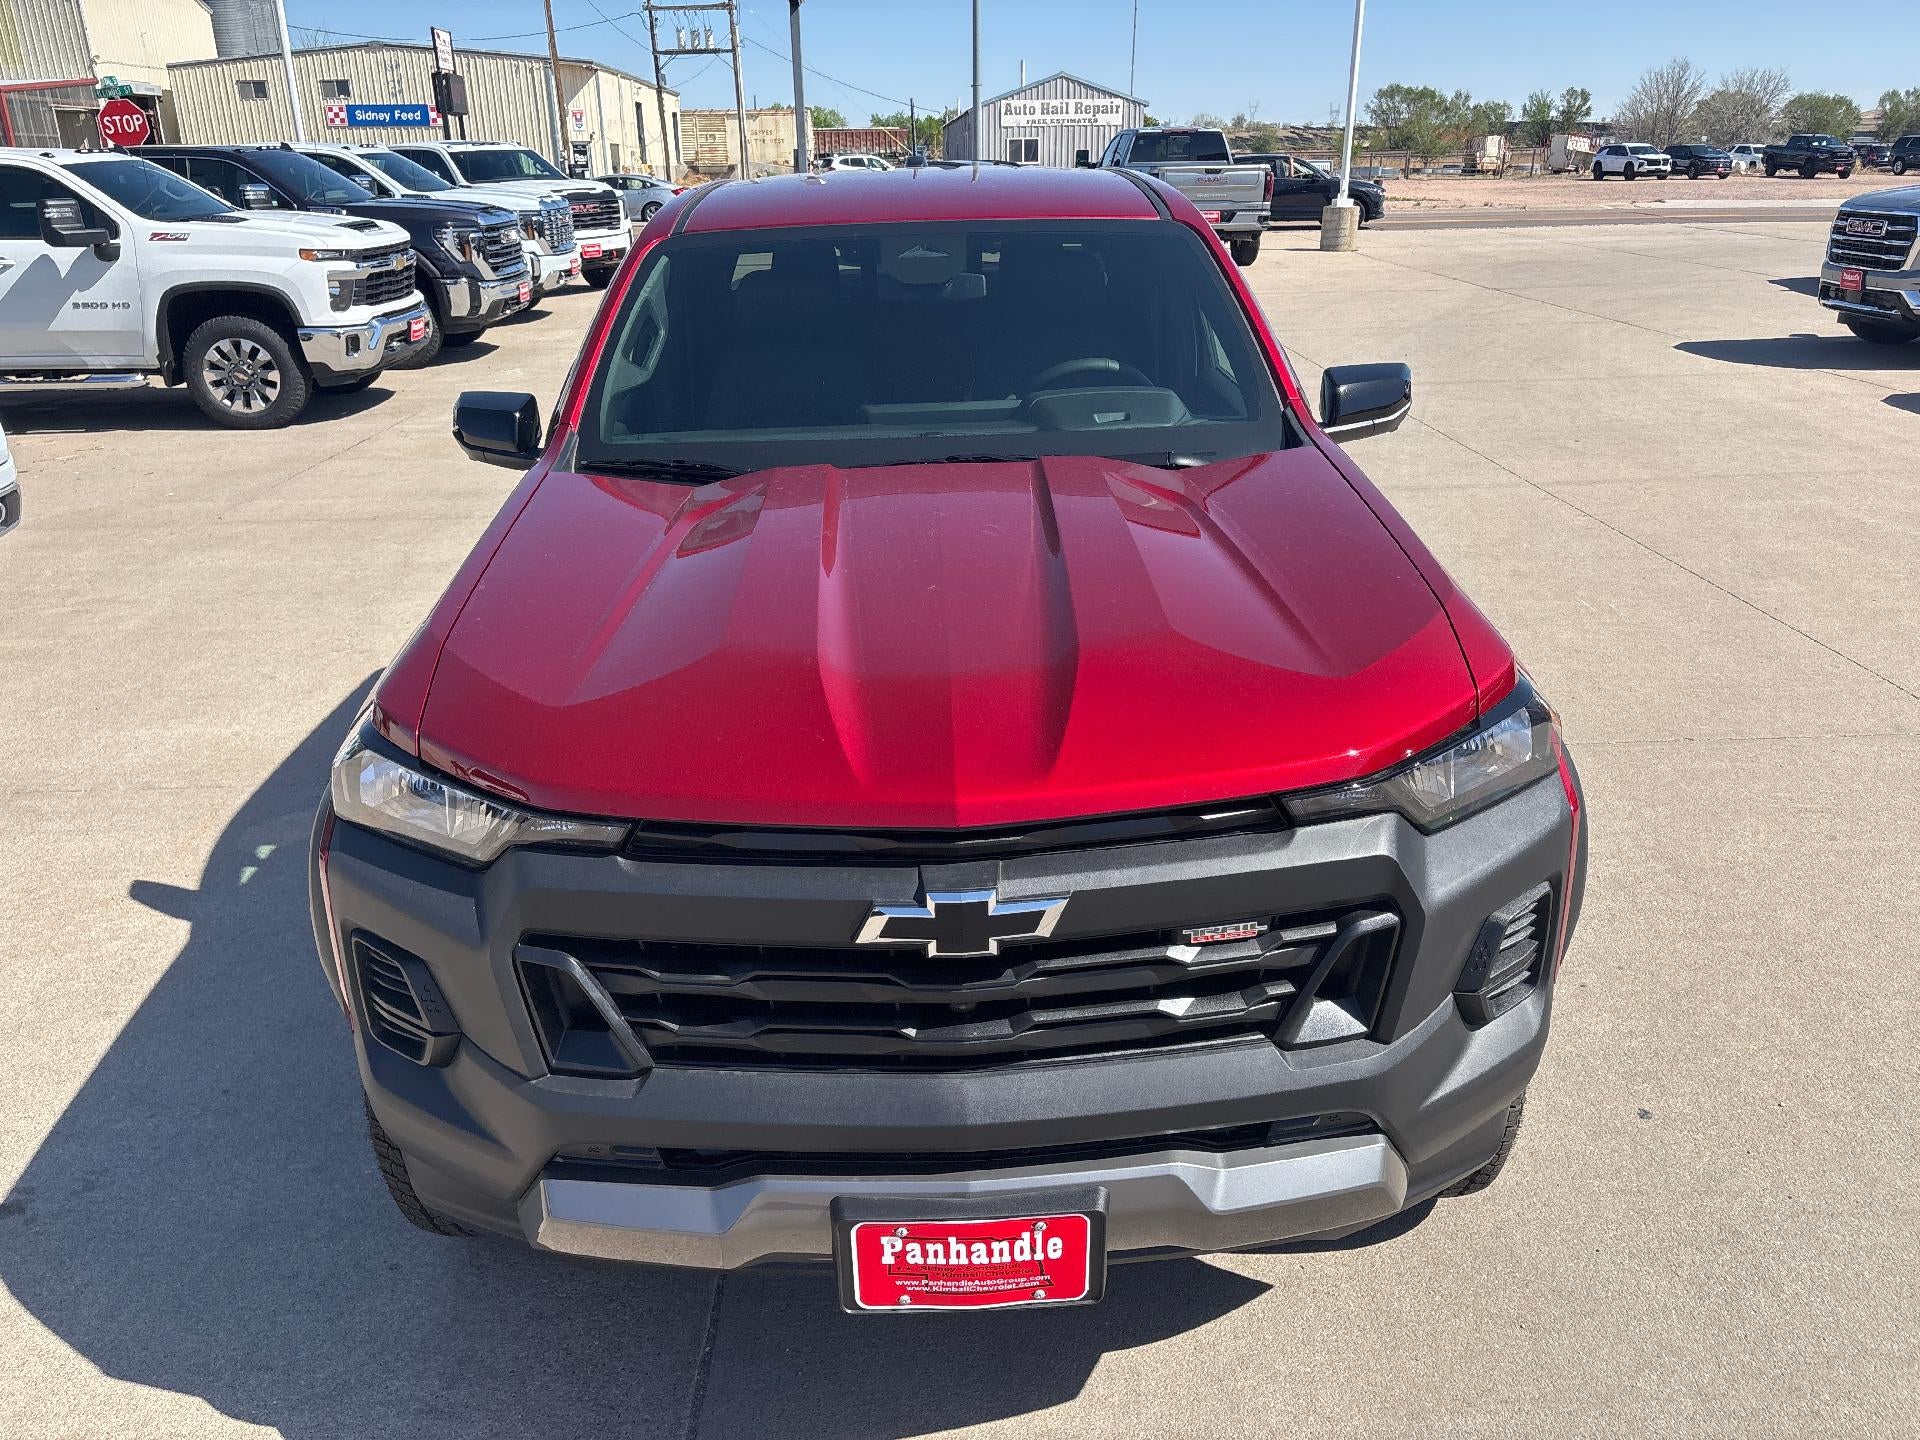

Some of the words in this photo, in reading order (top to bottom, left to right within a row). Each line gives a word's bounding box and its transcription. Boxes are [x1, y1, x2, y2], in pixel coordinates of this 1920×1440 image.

[1003, 101, 1036, 116] Auto
[1040, 101, 1069, 115] Hail
[1074, 100, 1121, 117] Repair
[355, 110, 390, 122] Sidney
[394, 110, 421, 120] Feed
[103, 114, 143, 135] STOP
[1848, 220, 1883, 234] GMC
[1183, 922, 1268, 935] TRAIL
[1191, 930, 1258, 943] BOSS
[880, 1232, 1064, 1265] Panhandle
[895, 1275, 1051, 1287] www.PanhandleAutoGroup.com
[906, 1281, 1040, 1293] www.KimballChevrolet.com
